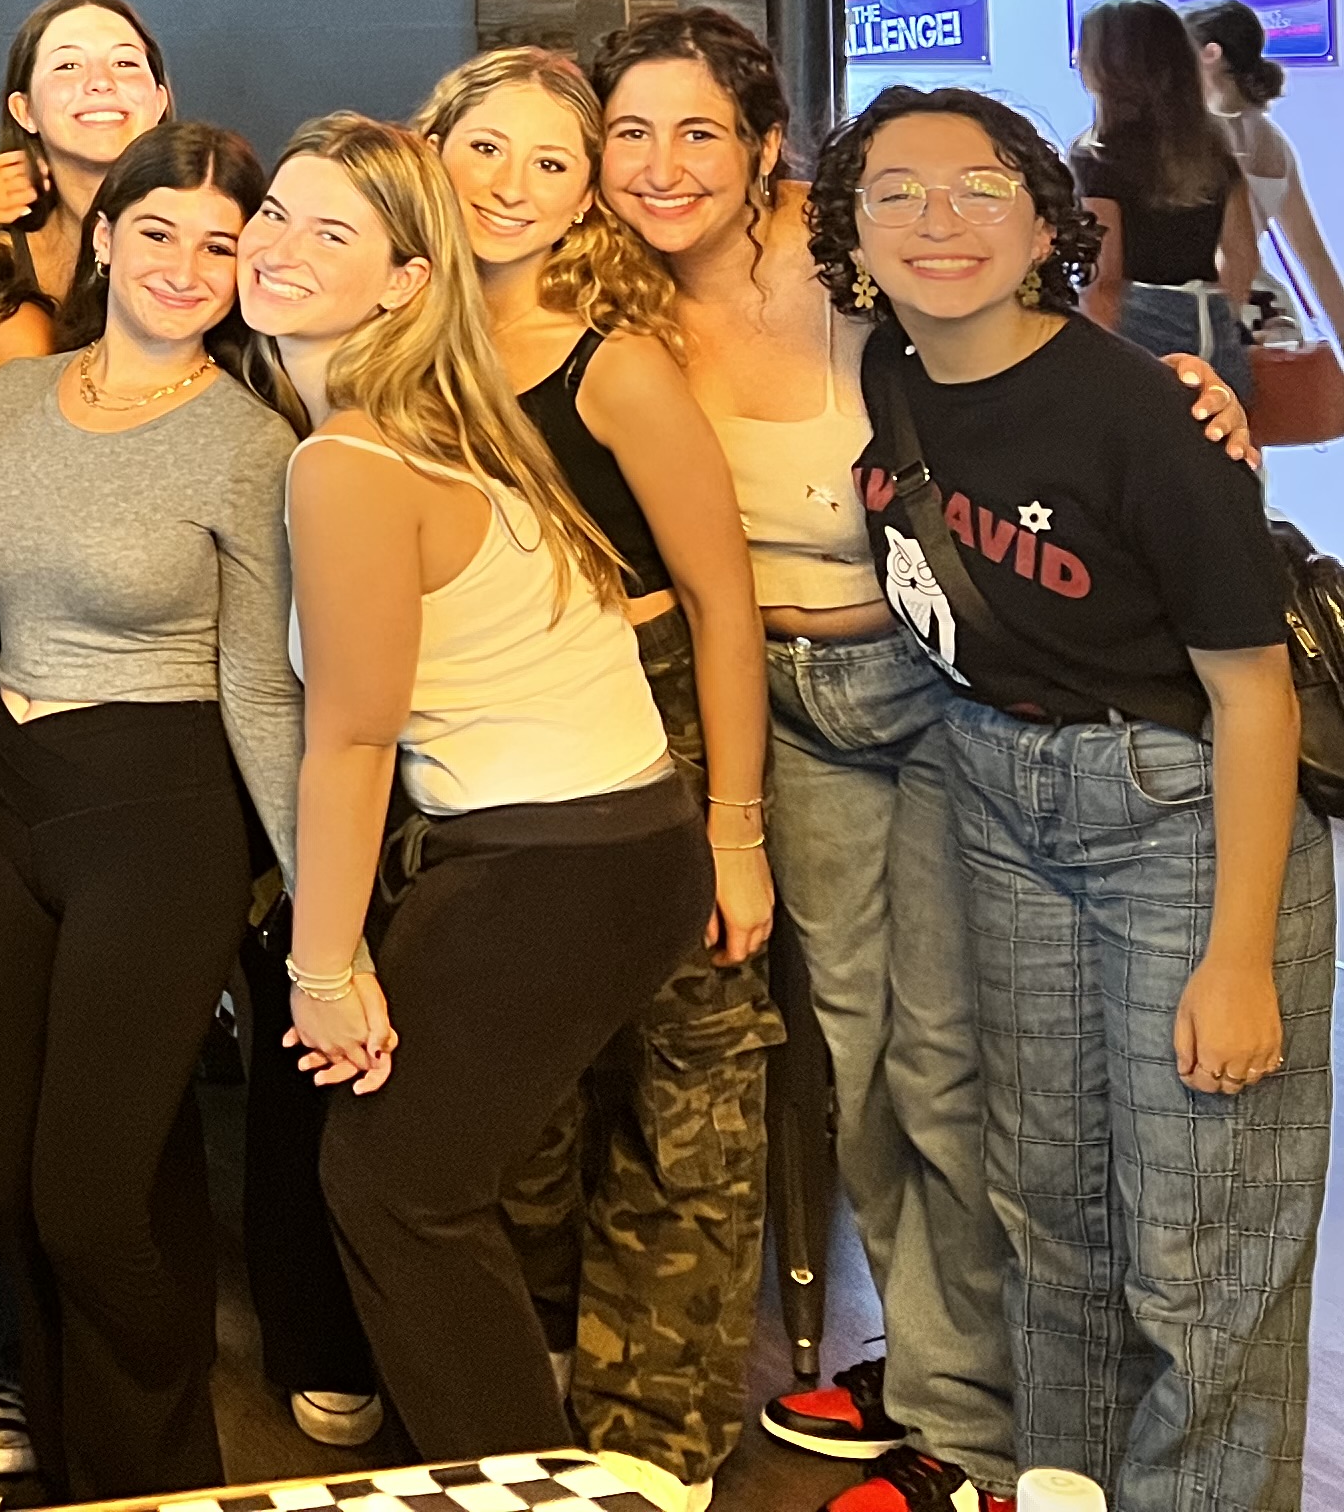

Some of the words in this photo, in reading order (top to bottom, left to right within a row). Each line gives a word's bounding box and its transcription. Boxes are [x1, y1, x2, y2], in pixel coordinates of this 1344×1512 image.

[844, 10, 962, 57] LLENGE!
[851, 3, 881, 25] THE
[932, 484, 1092, 600] AVID
